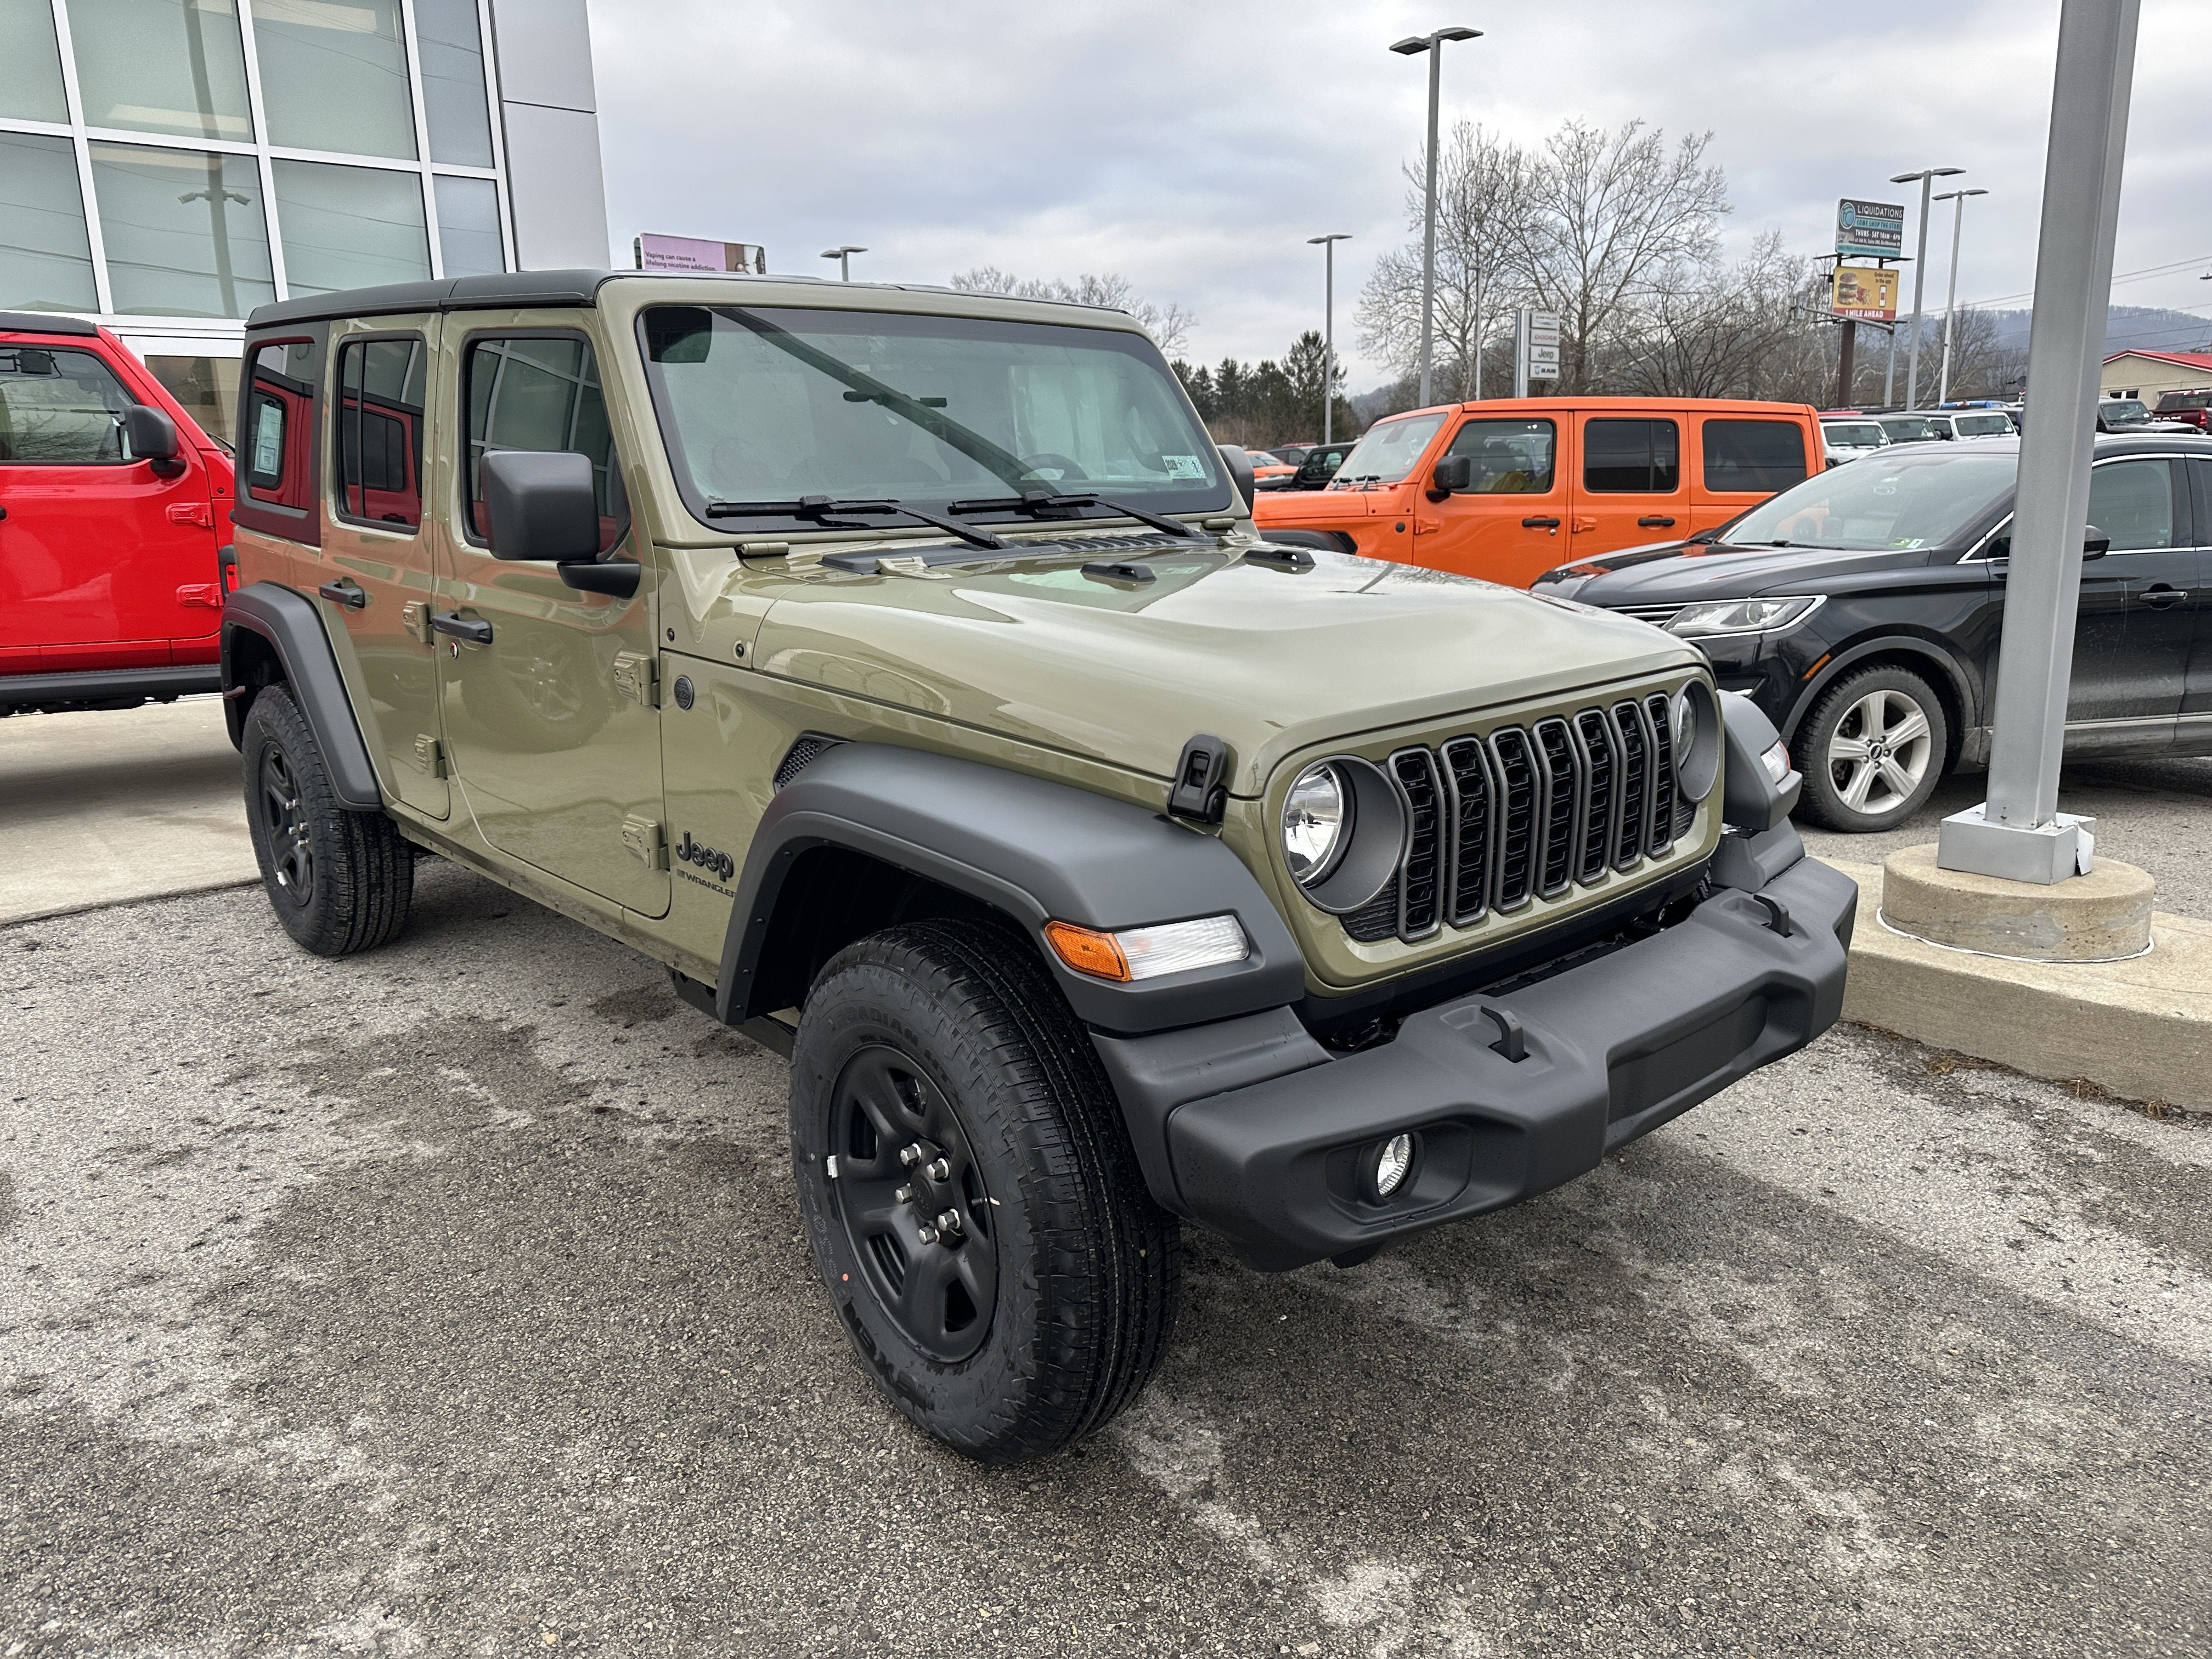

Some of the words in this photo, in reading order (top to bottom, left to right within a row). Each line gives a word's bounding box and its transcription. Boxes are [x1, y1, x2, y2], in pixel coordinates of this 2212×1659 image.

[1858, 205, 1903, 218] LIQUIDATIONS
[1855, 229, 1869, 237] THURS
[645, 251, 664, 260] Vaping
[646, 259, 667, 268] lifelong
[1538, 348, 1554, 360] Jeep
[675, 831, 734, 882] Jeep
